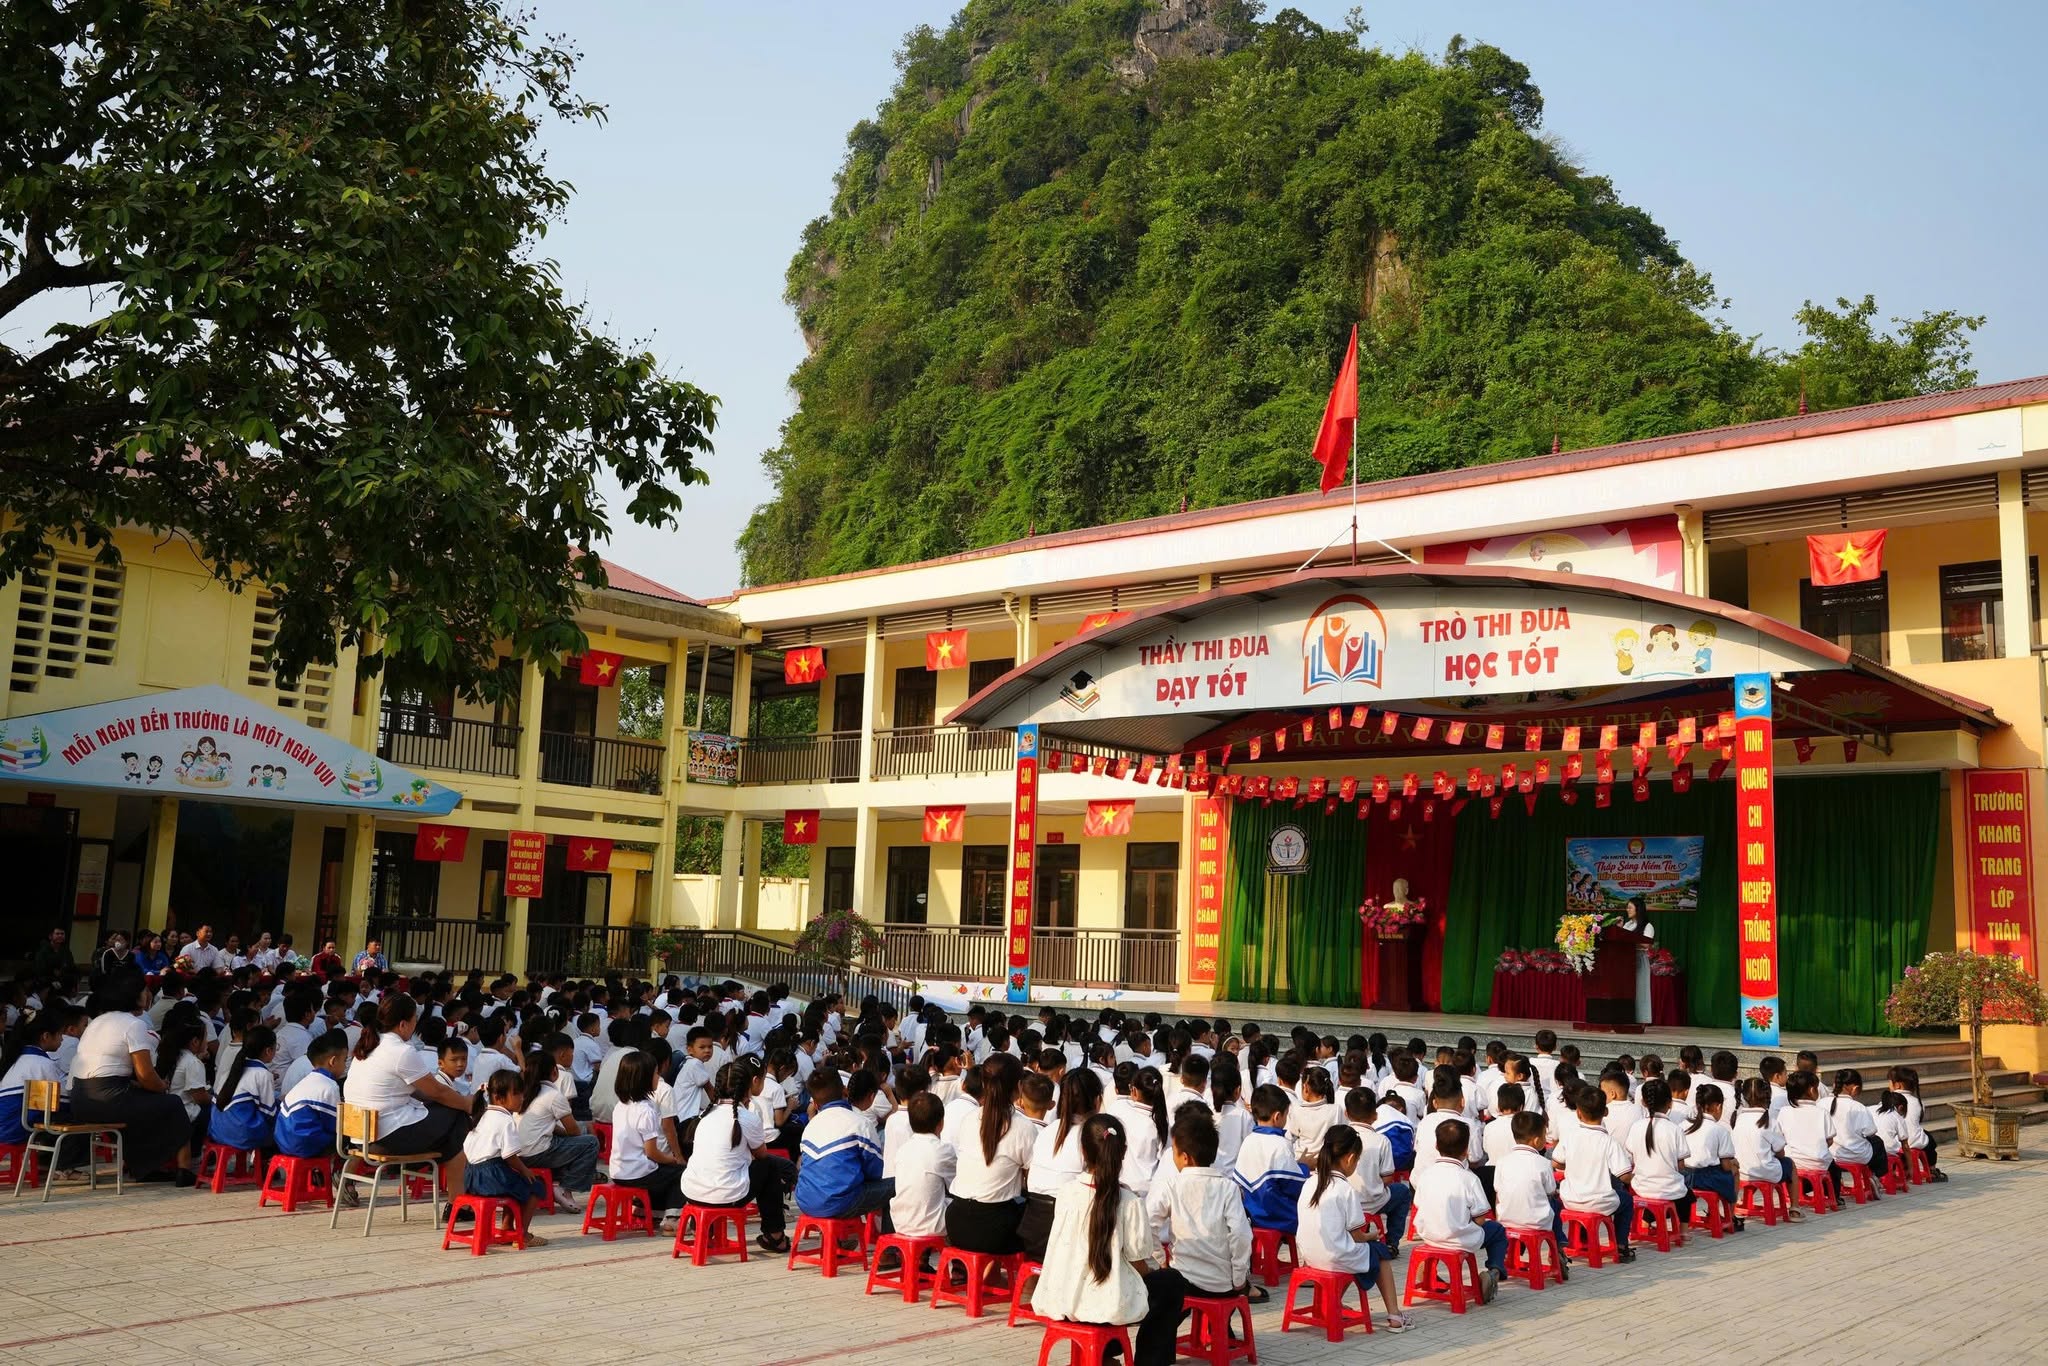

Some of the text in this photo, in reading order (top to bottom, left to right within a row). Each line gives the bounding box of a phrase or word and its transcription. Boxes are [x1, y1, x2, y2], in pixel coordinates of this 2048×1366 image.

[1419, 606, 1571, 643] TRÒ THI ĐUA
[1138, 634, 1269, 666] THẦY THI ĐUA
[1445, 636, 1559, 688] HỌC TỐT
[1156, 663, 1248, 708] DẠY TỐT
[61, 707, 337, 787] MỖI NGÀY ĐẾN TRƯỜNG LÀ MỘT NGÀY VUI
[1744, 730, 1763, 752] VINH
[1741, 767, 1768, 792] QUANG
[1974, 789, 2023, 811] TRƯỜNG
[1748, 805, 1762, 828] CHI
[1978, 825, 2021, 843] KHANG
[1747, 842, 1764, 865] HƠN
[1662, 860, 1677, 872] Tin
[1980, 857, 2022, 876] TRANG
[1201, 883, 1214, 899] TRÒ
[1742, 876, 1771, 909] NGHIỆP
[1990, 886, 2015, 908] LỚP
[1196, 907, 1218, 923] CHĂM
[1195, 933, 1218, 948] NGOAN
[1987, 918, 2020, 941] THÂN
[1746, 953, 1771, 981] NGƯỜI
